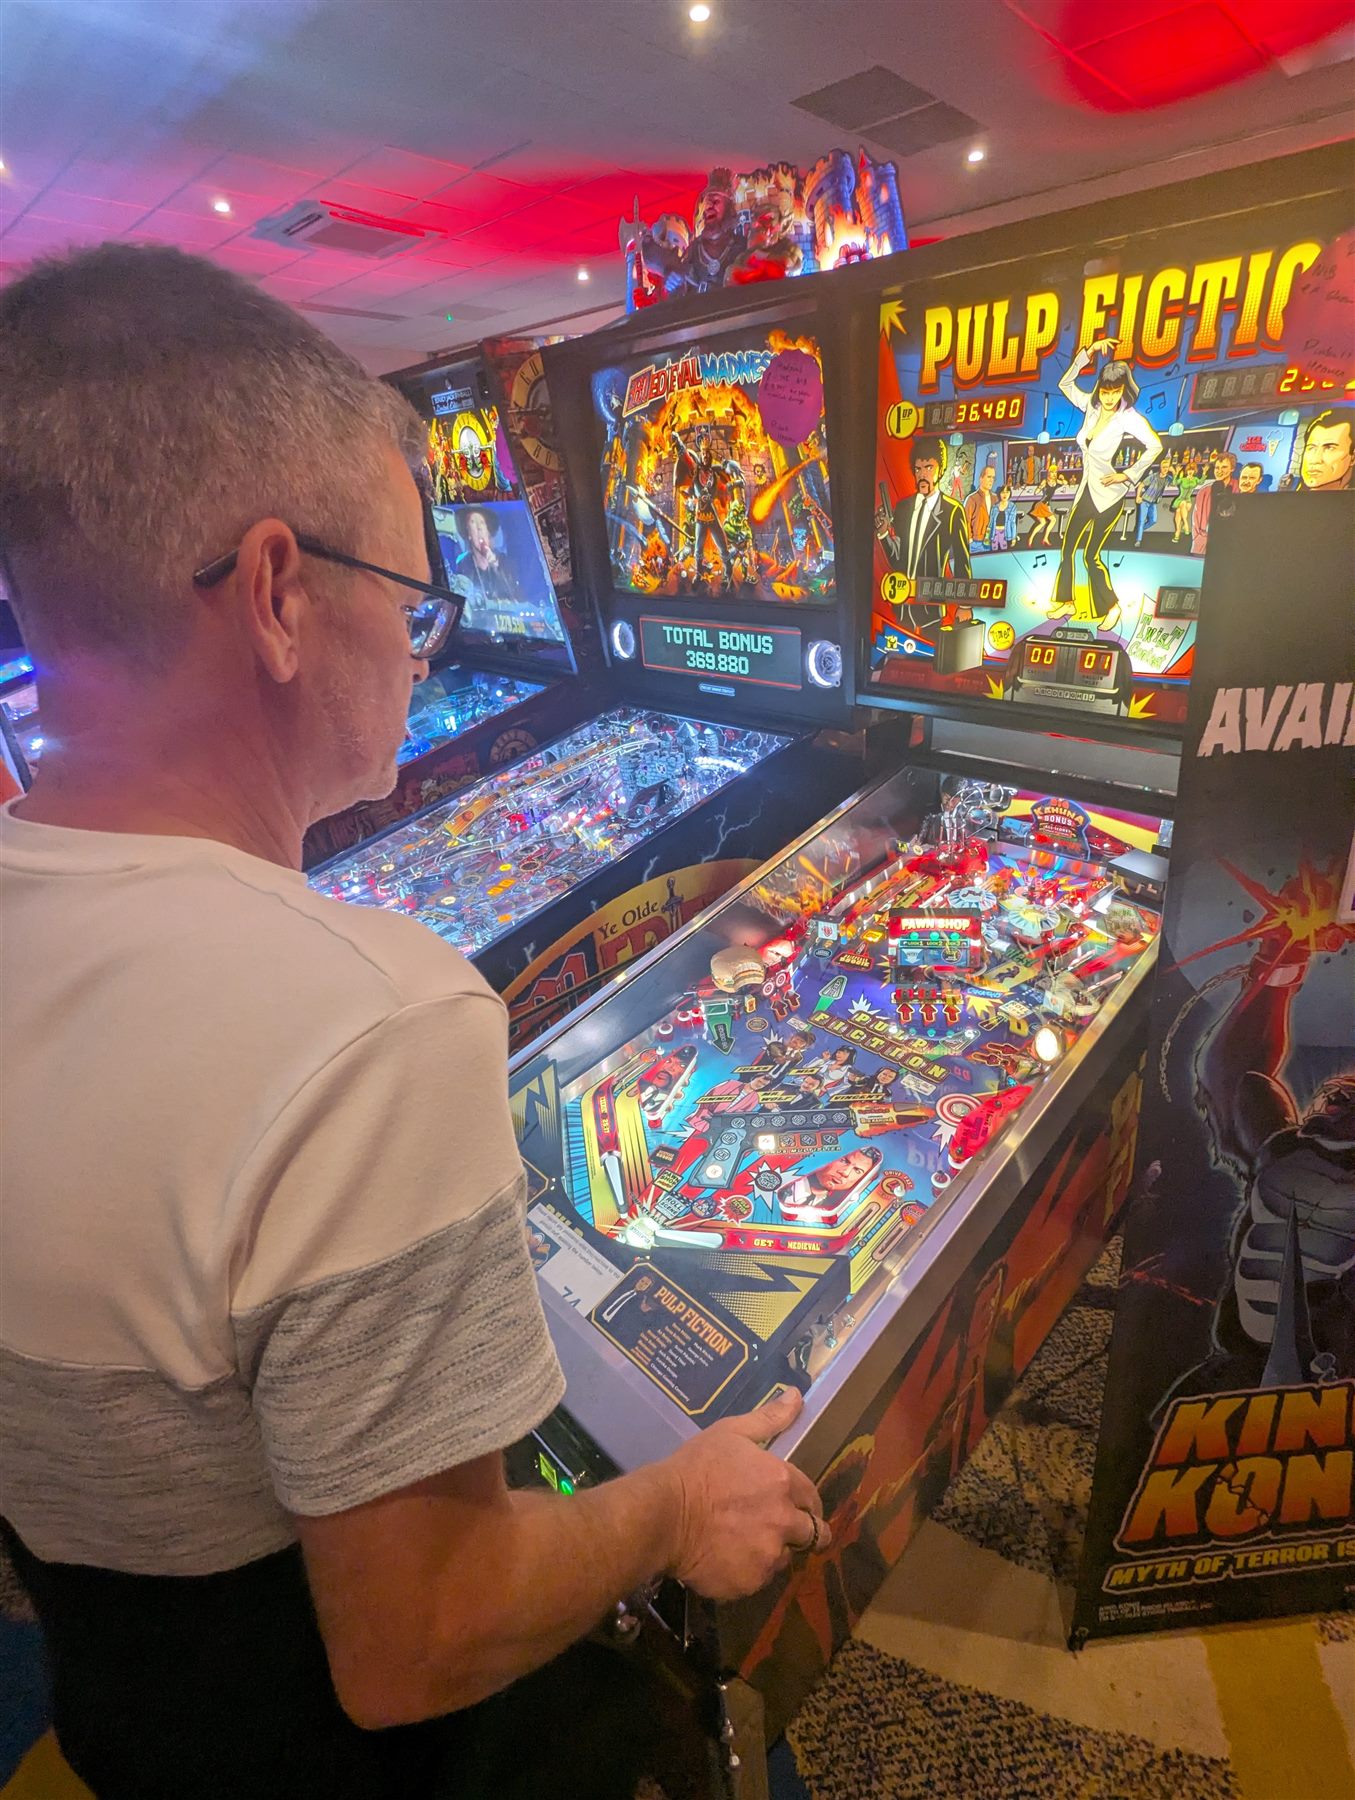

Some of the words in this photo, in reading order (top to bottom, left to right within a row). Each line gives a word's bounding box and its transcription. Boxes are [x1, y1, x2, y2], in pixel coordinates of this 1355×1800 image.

[920, 291, 1060, 392] PULP
[1081, 241, 1323, 370] FICTIO
[631, 356, 702, 406] MEDIEVAL
[701, 351, 777, 389] MADNES
[903, 408, 913, 418] UP
[957, 398, 1021, 423] 36,480
[888, 575, 897, 599] 3
[897, 580, 907, 588] UP
[980, 583, 1003, 599] 00
[662, 626, 714, 648] TOTAL
[718, 631, 774, 655] BONUS
[686, 650, 750, 675] 369.880
[1030, 647, 1055, 665] 00
[1084, 653, 1111, 670] 01
[1196, 682, 1355, 758] AVAI
[1033, 806, 1085, 826] KAHUNA
[1043, 815, 1073, 826] BONUS
[597, 922, 618, 940] Ye
[622, 901, 659, 926] Olde
[901, 918, 935, 930] PAWN
[938, 918, 970, 931] SHOP
[855, 1012, 928, 1048] PULP
[814, 1012, 948, 1078] FICTION
[660, 1201, 678, 1215] SCENE
[666, 1197, 681, 1210] ROLL
[753, 1238, 774, 1248] GET
[787, 1241, 821, 1251] MEDIEVAL
[653, 1286, 687, 1315] PULP
[680, 1307, 733, 1356] FICTION
[1154, 1387, 1355, 1465] KIN
[1122, 1450, 1354, 1544] KON
[1109, 1560, 1187, 1586] MYTH
[1193, 1556, 1228, 1575] OF
[1232, 1543, 1332, 1569] TERROR
